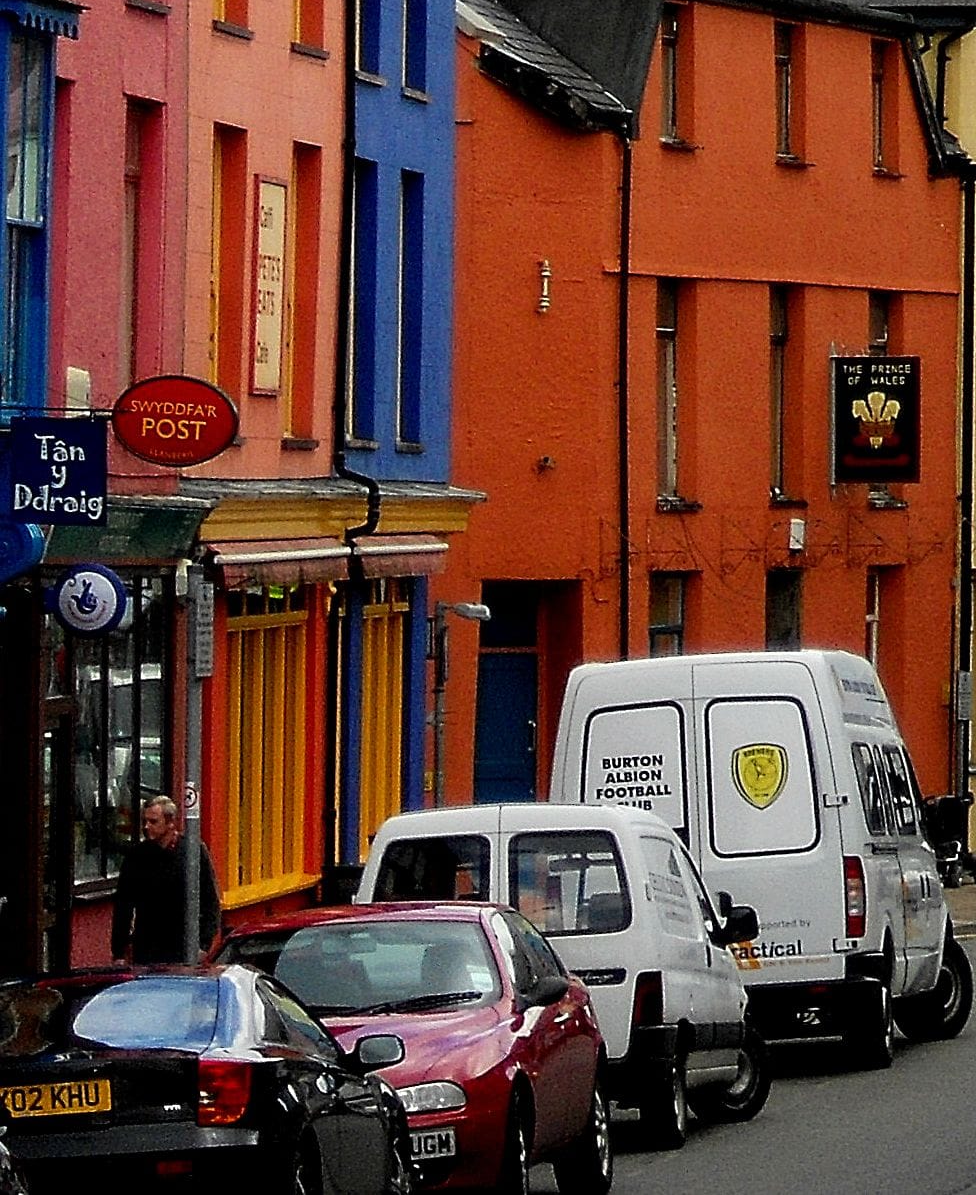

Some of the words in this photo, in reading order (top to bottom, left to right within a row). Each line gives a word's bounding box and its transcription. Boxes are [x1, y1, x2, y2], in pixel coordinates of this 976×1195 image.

[843, 365, 863, 374] THE
[871, 365, 911, 374] PRINCE
[847, 376, 861, 385] OF
[870, 376, 906, 385] WALES
[131, 400, 217, 418] SWYDDFA'R
[141, 417, 207, 441] POST
[34, 433, 86, 462] Tân
[50, 465, 67, 489] y
[14, 483, 104, 520] Ddraig
[602, 754, 663, 769] BURTON
[605, 770, 662, 784] ALBION
[596, 785, 672, 800] FOOTBALL
[732, 940, 802, 959] ractical
[51, 1082, 100, 1109] KHU
[411, 1132, 451, 1156] UGM
